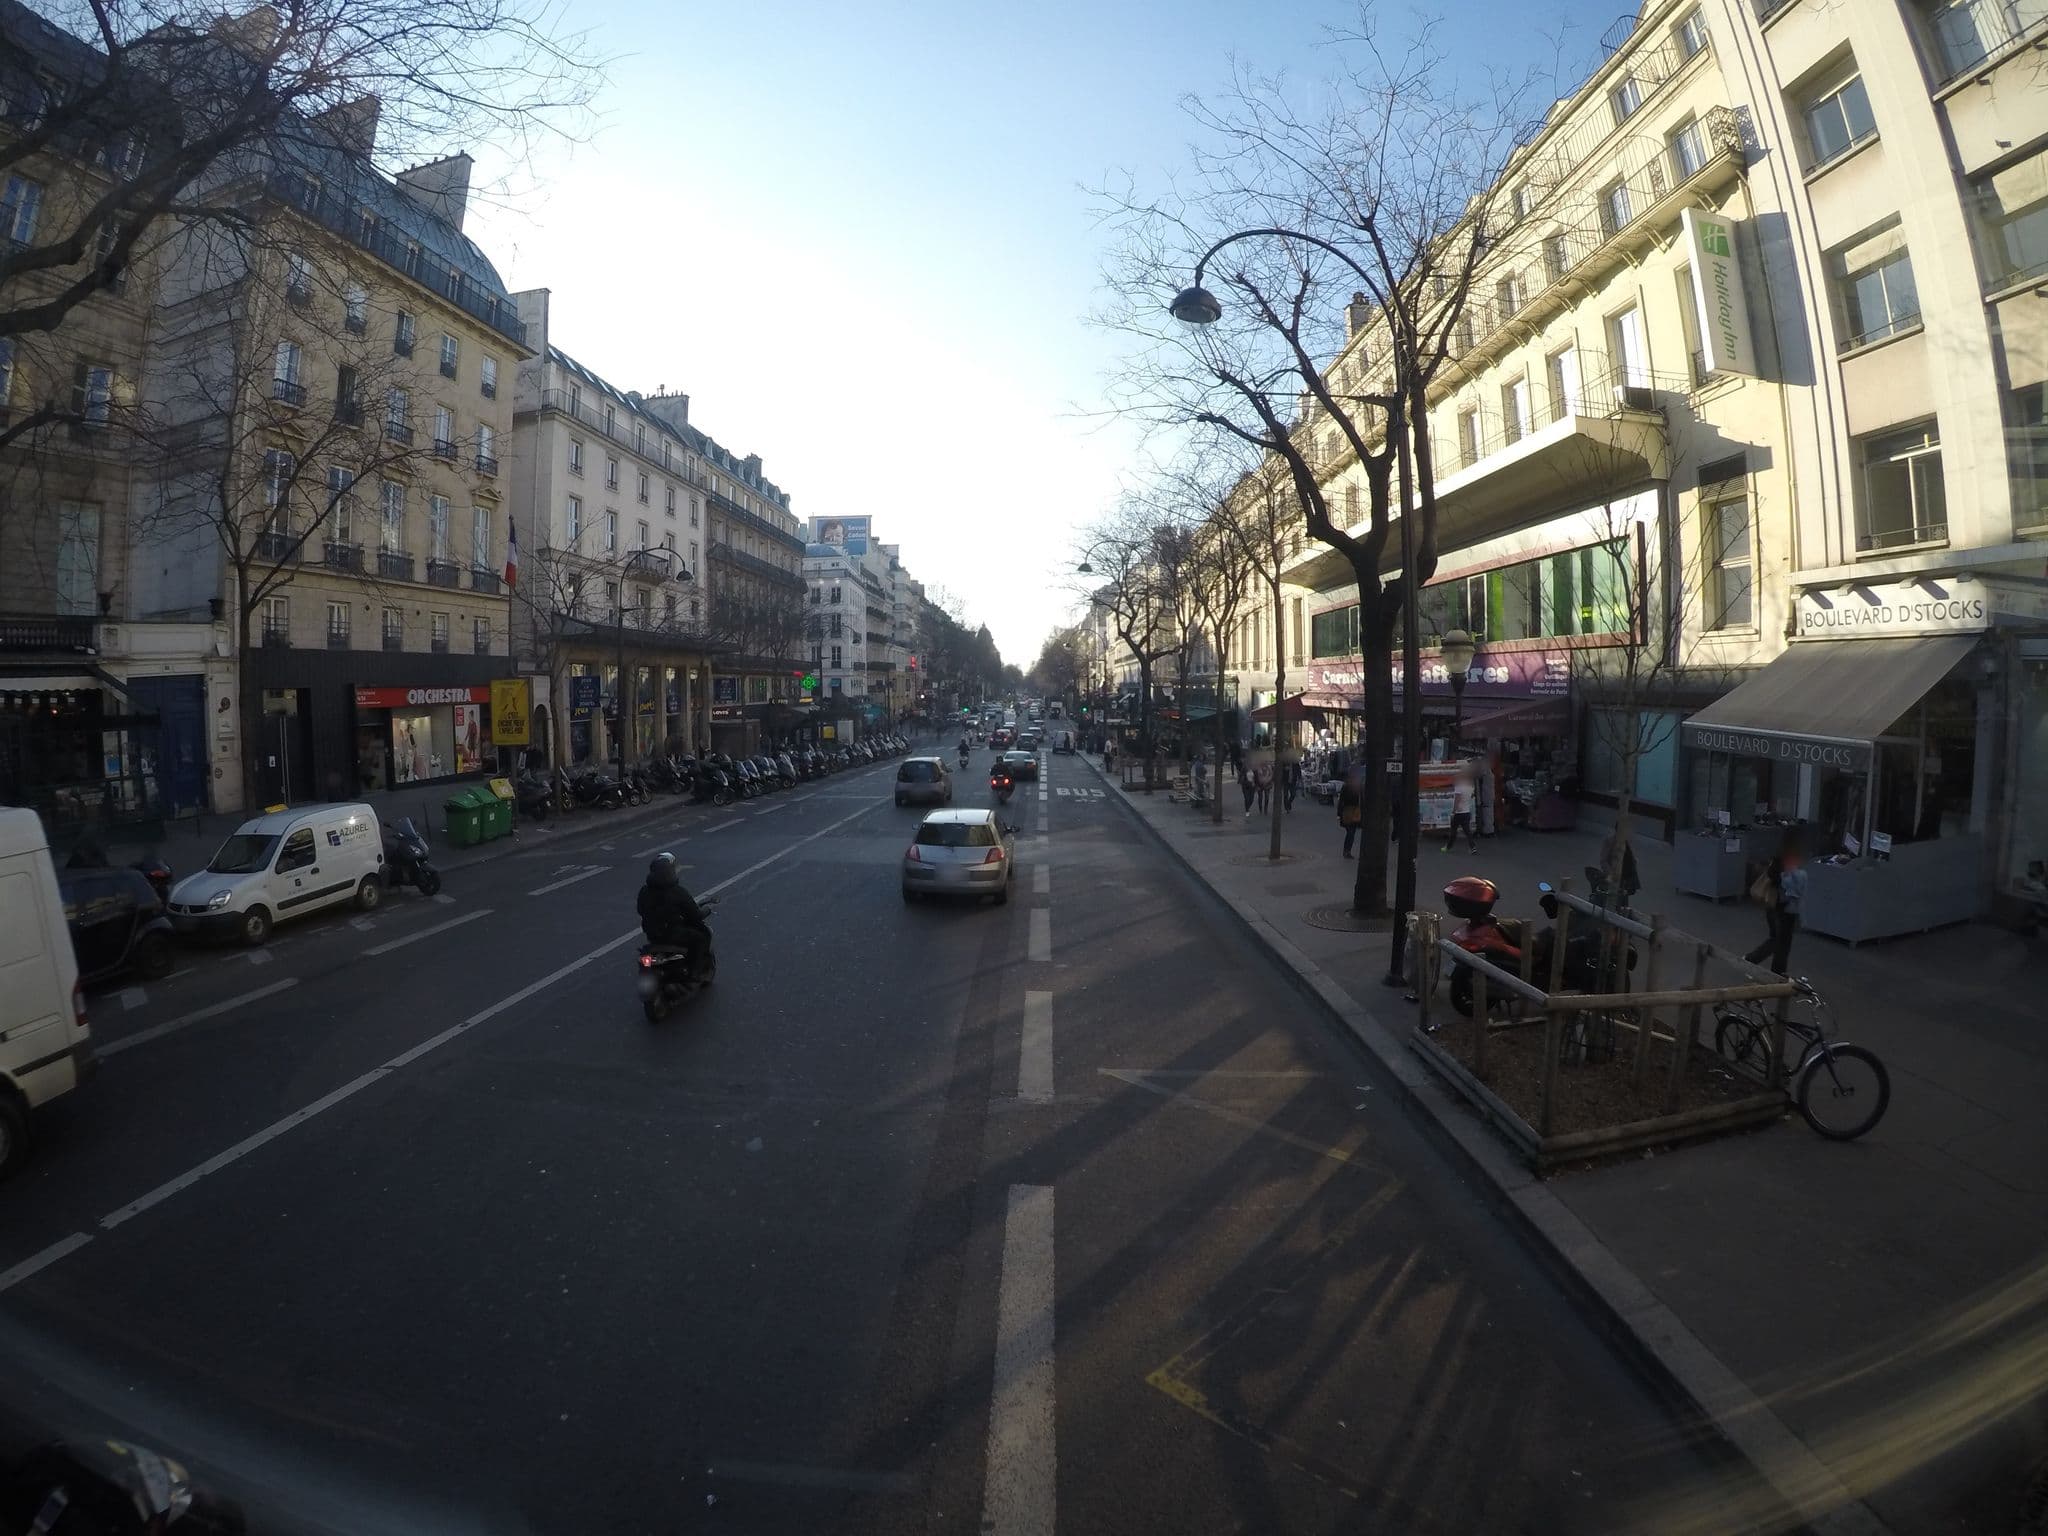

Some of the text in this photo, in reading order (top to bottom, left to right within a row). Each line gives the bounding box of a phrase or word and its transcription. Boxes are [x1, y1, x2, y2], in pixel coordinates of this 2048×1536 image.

[1712, 261, 1738, 360] Holiday Inn
[1805, 599, 1983, 629] BOULEVARD D'STOCKS
[1421, 664, 1509, 685] affres
[408, 688, 471, 704] ORCHESTRA
[1697, 731, 1852, 766] BOULEVARD D'STOCKS
[1056, 787, 1106, 798] BUS
[339, 823, 369, 837] AZUREL
